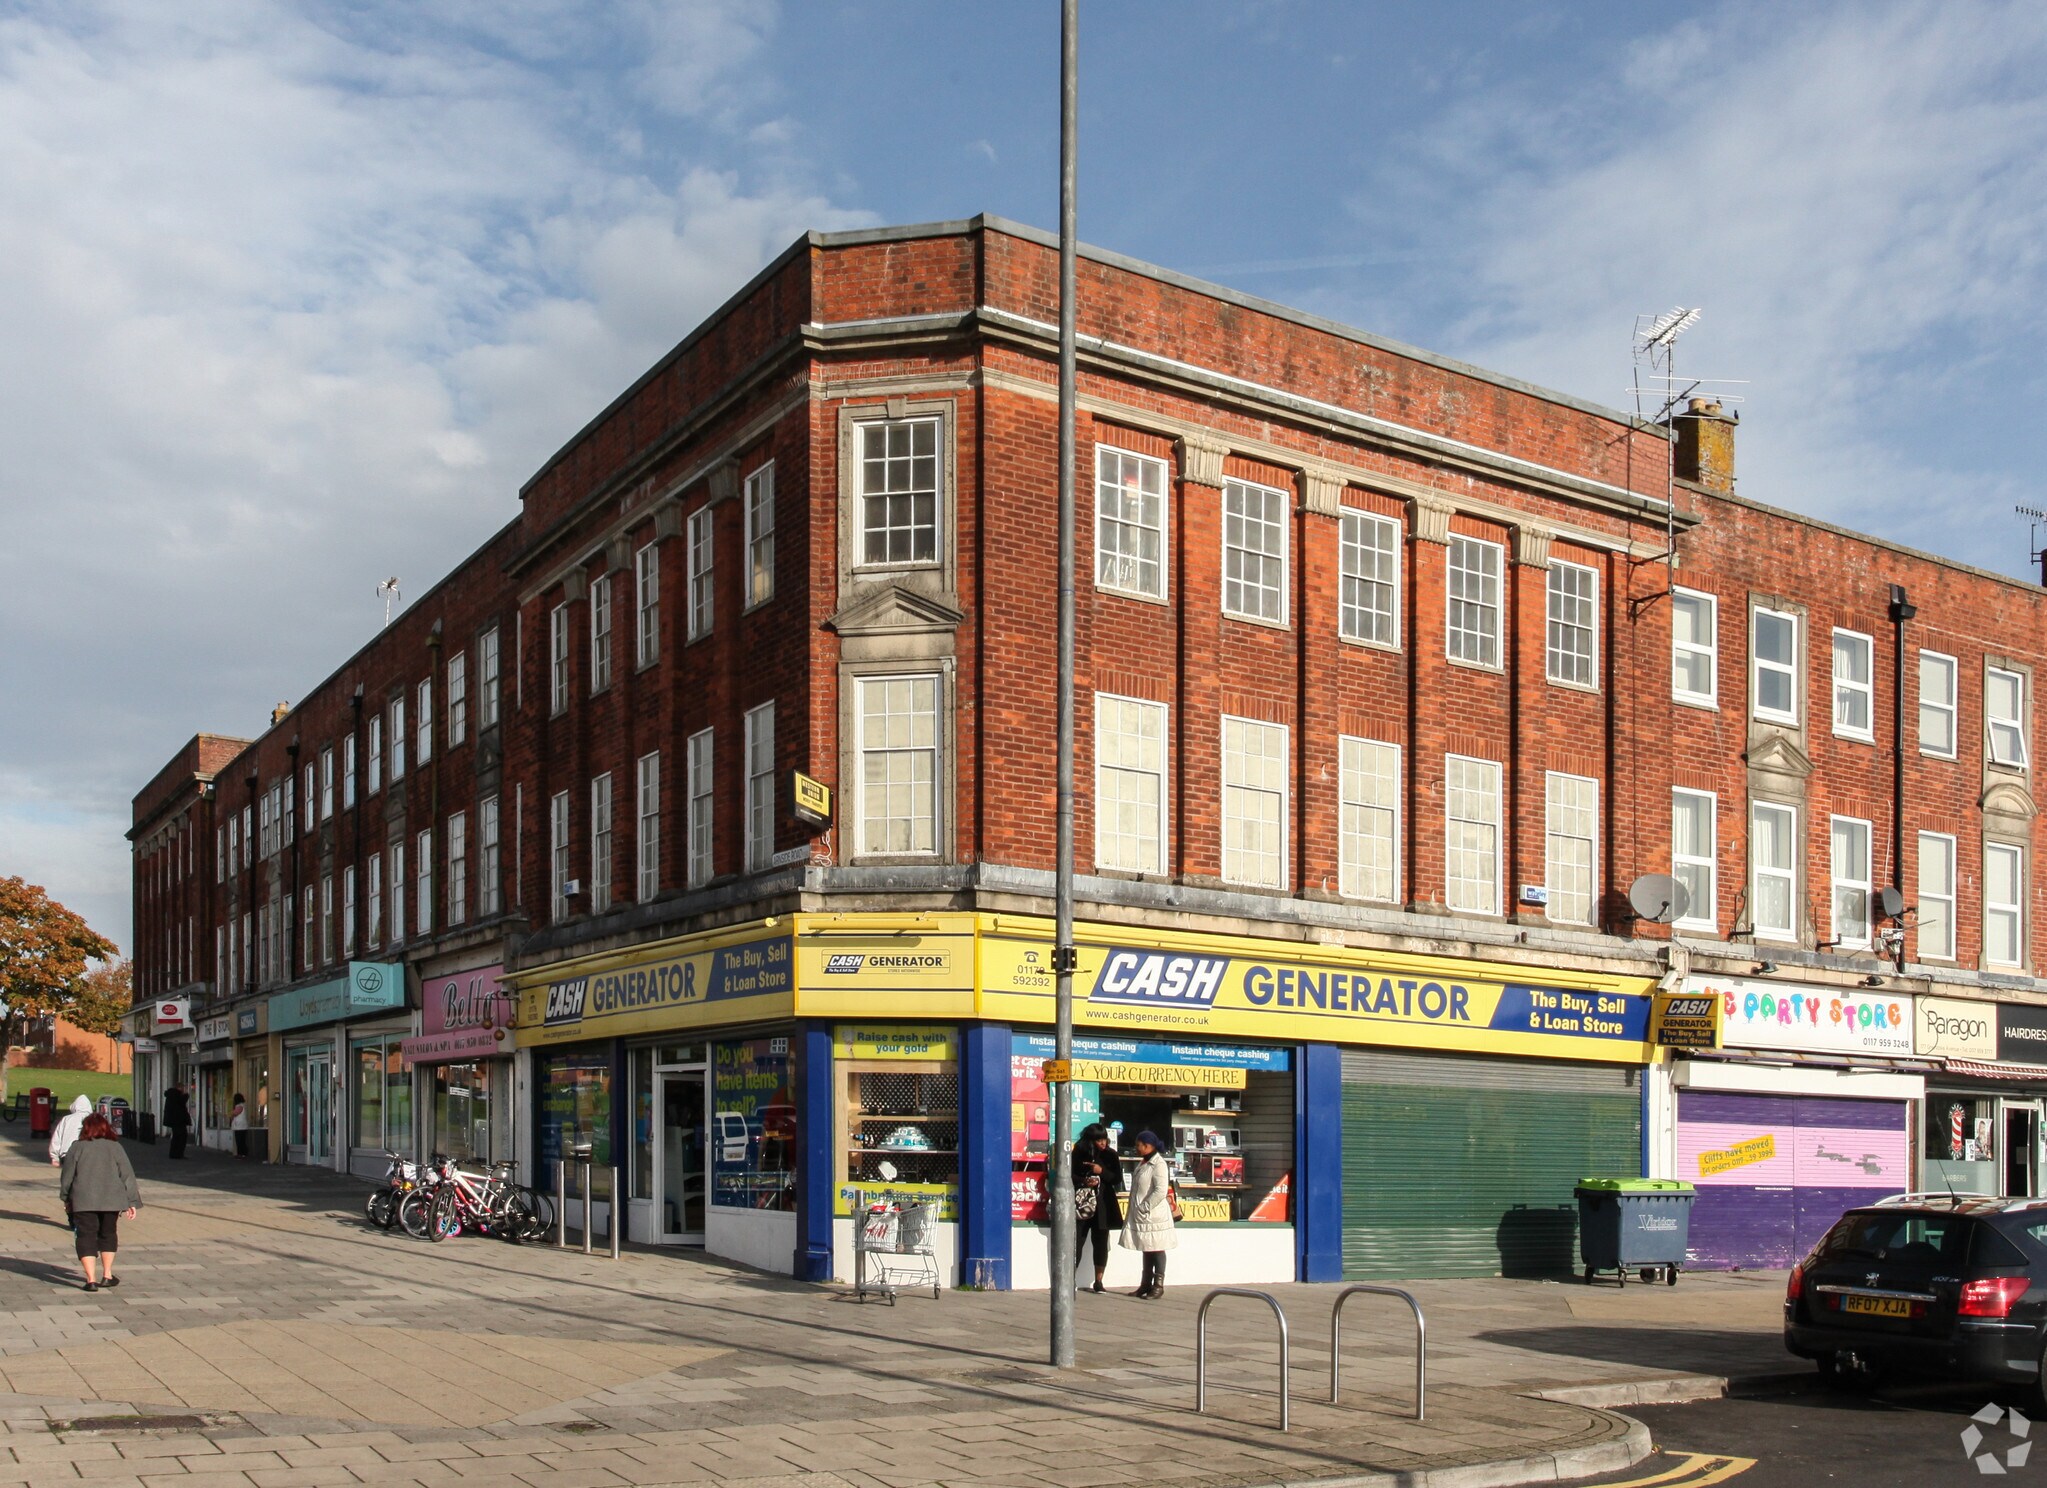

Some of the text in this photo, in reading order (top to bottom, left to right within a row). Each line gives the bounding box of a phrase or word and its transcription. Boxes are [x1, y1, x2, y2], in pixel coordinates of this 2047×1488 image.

[724, 942, 786, 970] The Buy, Sell
[830, 955, 942, 966] CASH GENERATOR
[724, 970, 786, 993] & Loan Store
[1012, 977, 1050, 987] 592392
[1101, 953, 1470, 1021] CASH GENERATOR
[546, 962, 696, 1018] CASH GENERATOR
[353, 994, 386, 1004] pharmacy
[442, 975, 494, 1029] Bella
[1530, 991, 1625, 1014] The Buy, Sell
[1668, 1000, 1710, 1014] CASH
[1086, 1010, 1209, 1025] www.cashgenerator.co.uk
[1743, 993, 1821, 1026] PARTY
[1829, 999, 1902, 1032] STORE
[1530, 1013, 1623, 1034] & Loan Store
[1663, 1019, 1712, 1027] GENERATOR
[1927, 1010, 1987, 1041] Paragon
[858, 1032, 946, 1042] Raise cash with
[2004, 1026, 2047, 1040] HAIRDRES
[876, 1044, 928, 1054] your gold
[1030, 1036, 1136, 1053] Insta heque cashing
[1863, 1037, 1910, 1049] 0117 959 3248
[716, 1044, 754, 1068] Do you
[1011, 1056, 1020, 1065] et
[1172, 1046, 1270, 1060] Instant cheque cashing
[716, 1069, 778, 1090] have items
[1011, 1066, 1038, 1079] or it.
[1072, 1062, 1239, 1084] UY YOUR CURRENCY HERE
[716, 1095, 757, 1116] to sell?
[1083, 1098, 1097, 1113] it.
[1704, 1152, 1723, 1164] Cliffs
[1745, 1139, 1769, 1152] moved
[1746, 1154, 1756, 1162] 59
[1179, 1203, 1228, 1218] N TOWN
[1848, 1296, 1907, 1314] RF07 XJA
